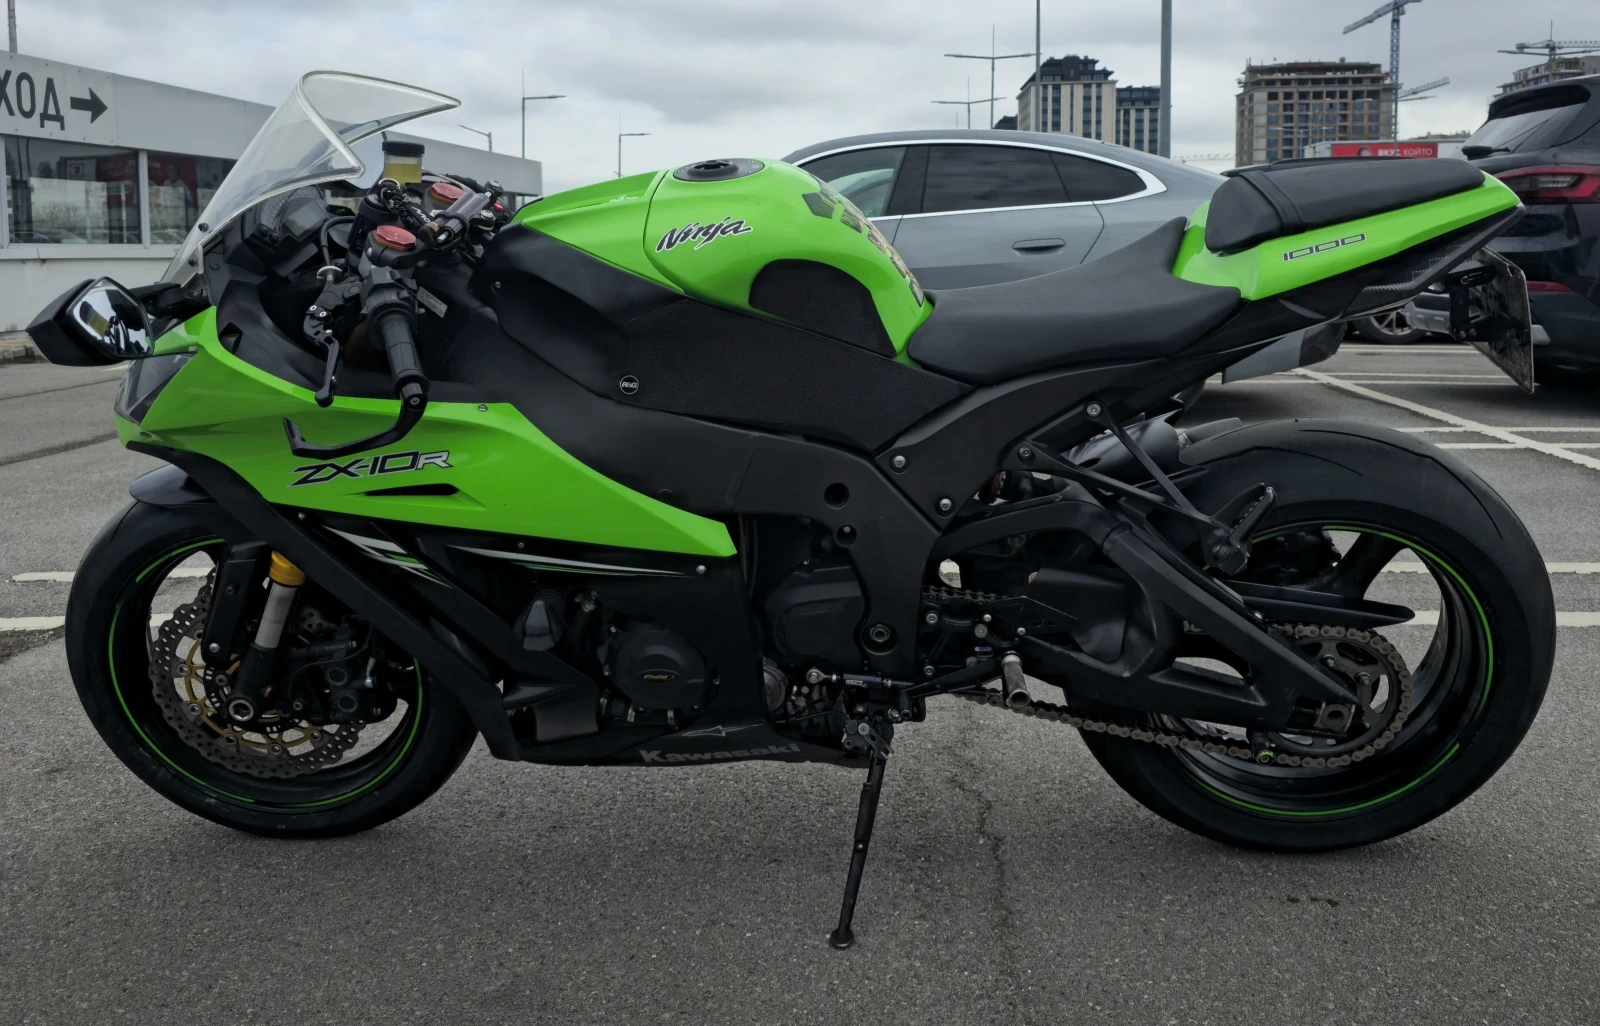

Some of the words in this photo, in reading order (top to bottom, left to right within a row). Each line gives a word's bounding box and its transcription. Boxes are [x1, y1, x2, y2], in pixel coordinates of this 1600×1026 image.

[655, 216, 753, 252] Ninja
[1283, 233, 1366, 262] 1000
[287, 450, 454, 487] ZX-10R
[640, 744, 801, 763] Kawasaki
